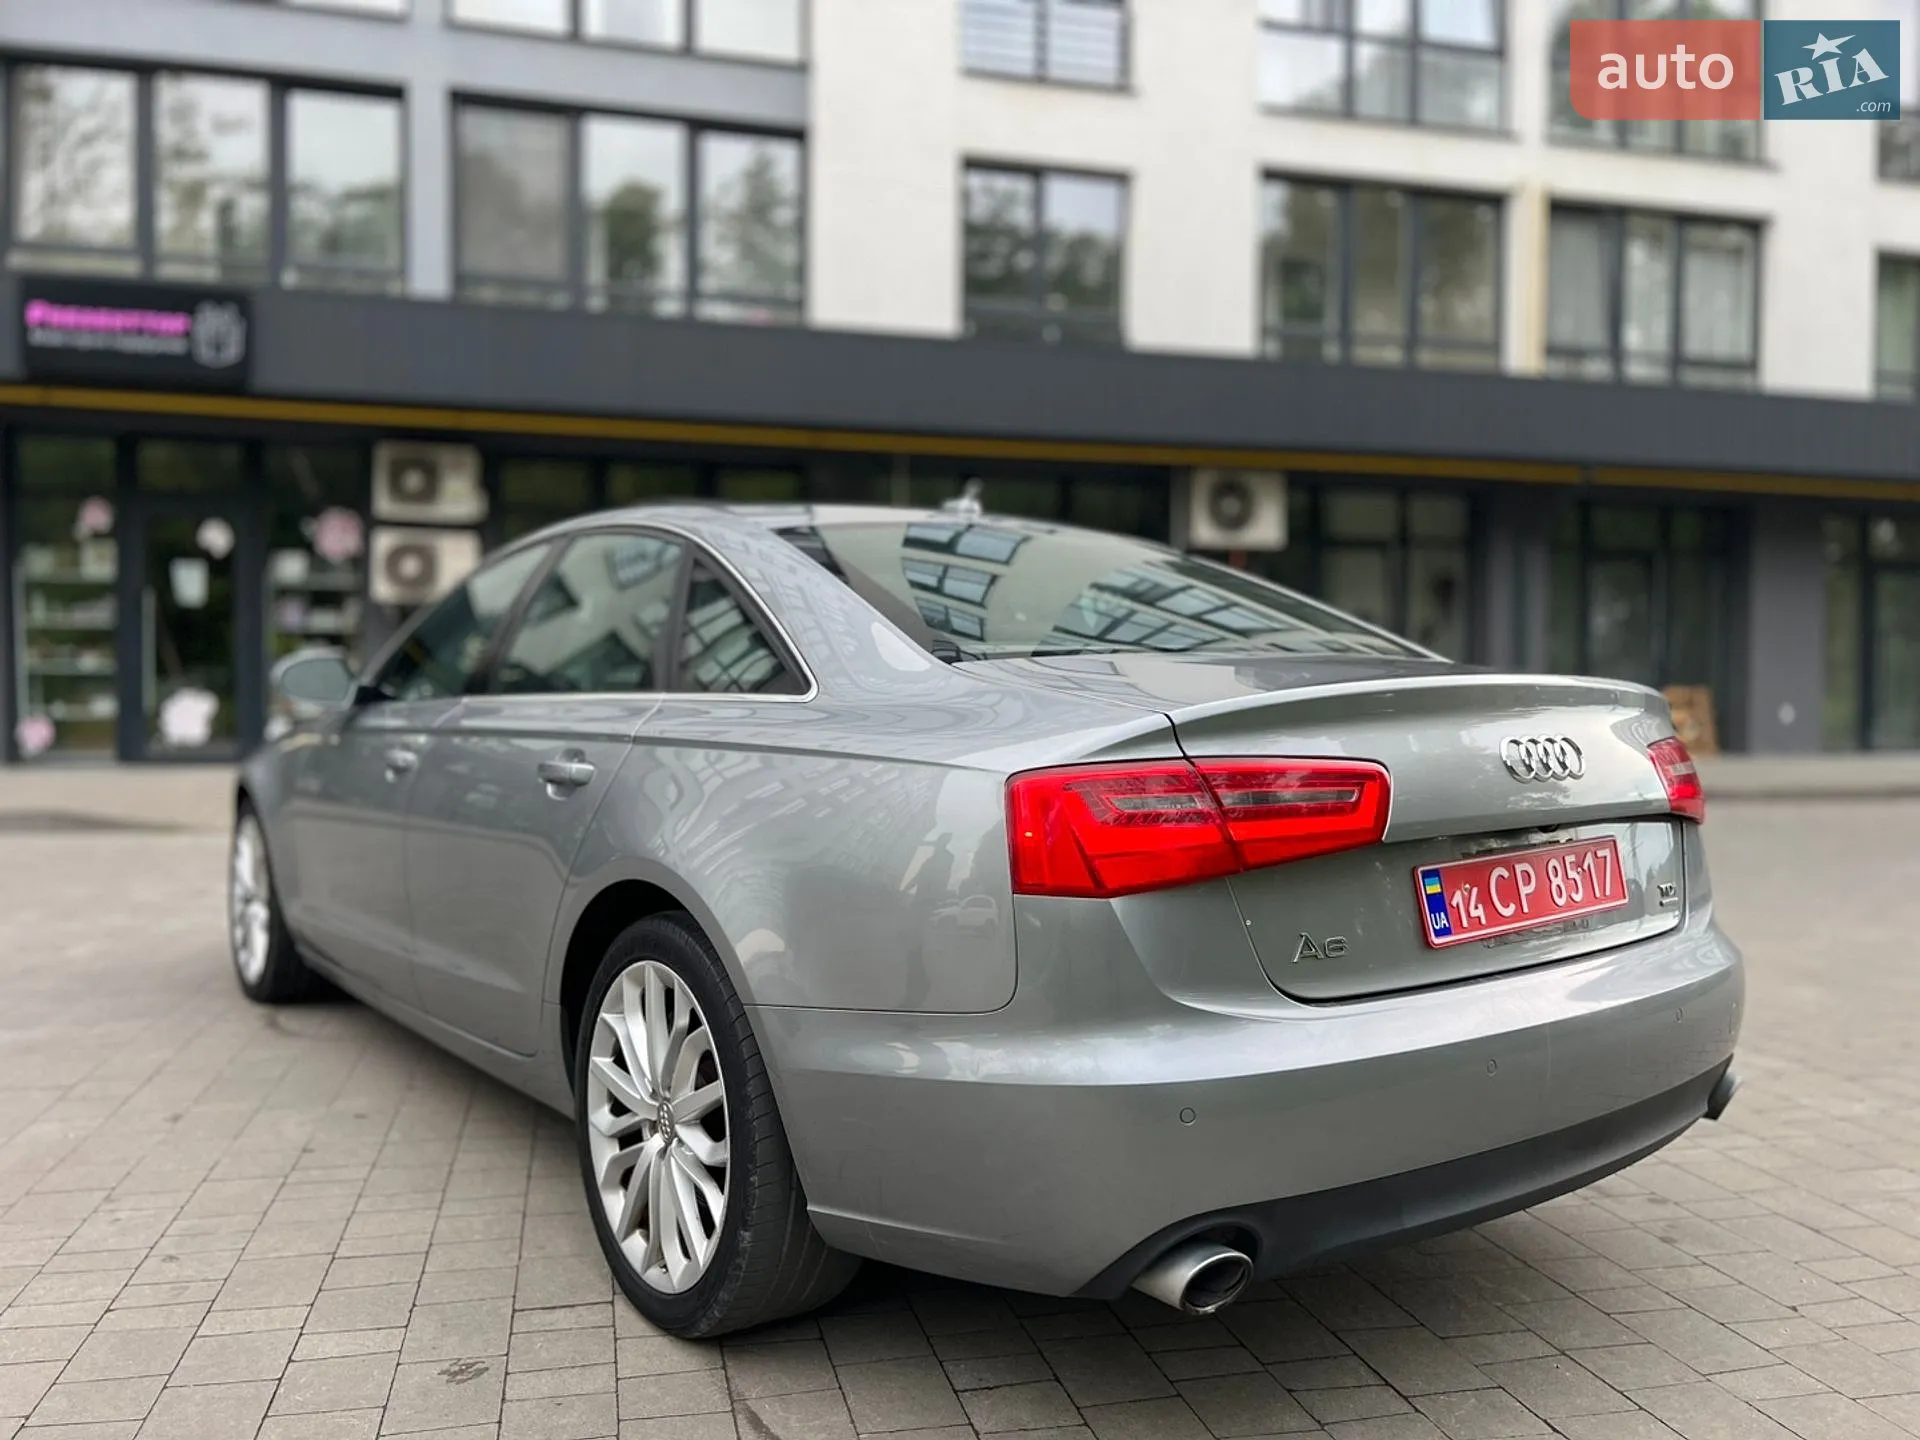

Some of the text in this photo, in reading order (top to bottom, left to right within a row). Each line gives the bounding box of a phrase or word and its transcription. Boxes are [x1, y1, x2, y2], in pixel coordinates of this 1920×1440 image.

[1450, 848, 1611, 928] 14 CP 8517
[1431, 912, 1449, 930] UA
[1293, 932, 1348, 963] A6
